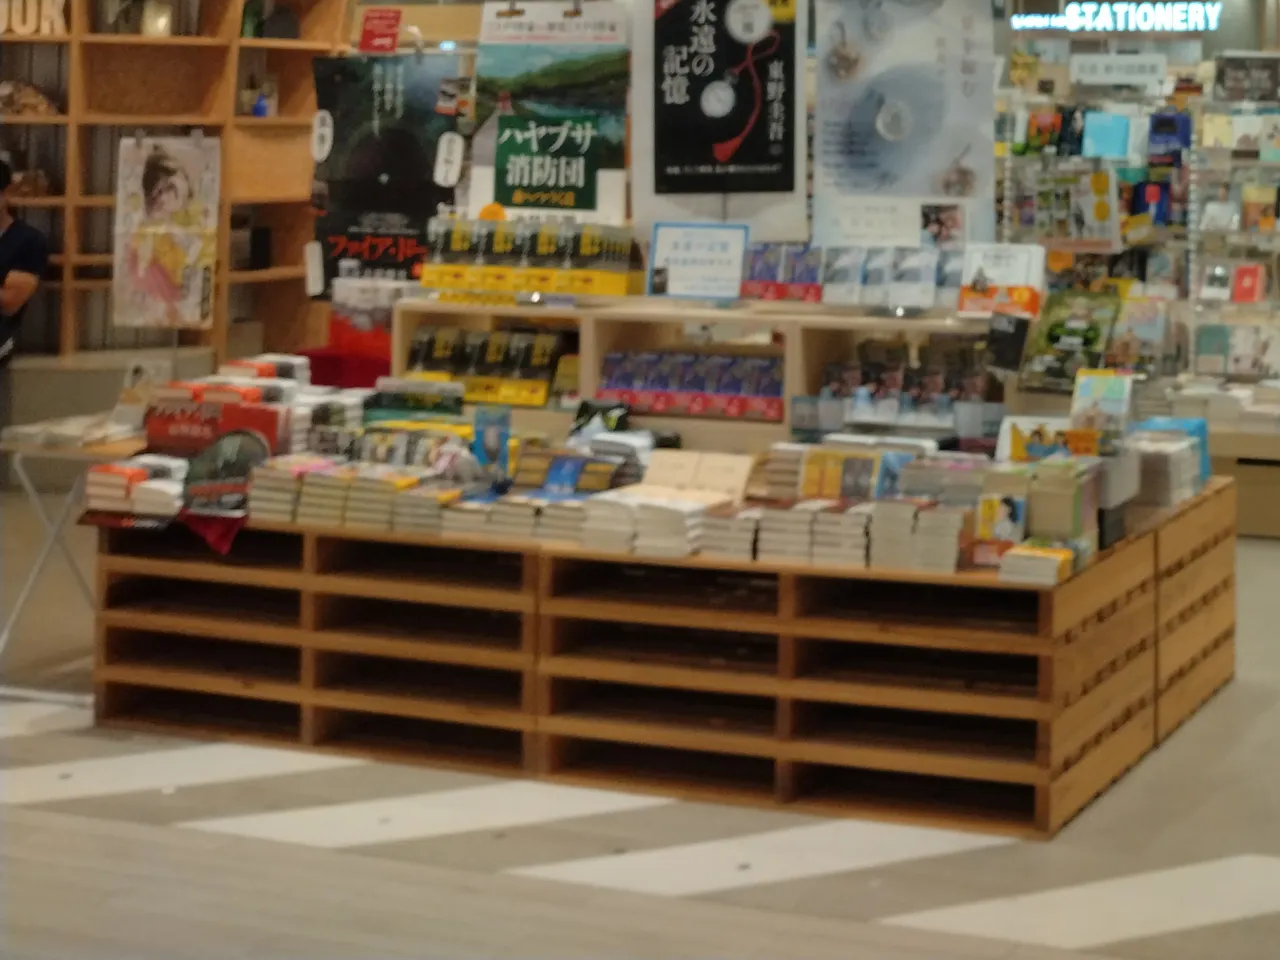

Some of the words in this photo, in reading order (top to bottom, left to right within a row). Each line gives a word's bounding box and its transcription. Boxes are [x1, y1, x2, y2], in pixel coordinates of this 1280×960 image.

[1065, 2, 1223, 31] STATIONERY
[499, 120, 597, 154] ハヤブサ
